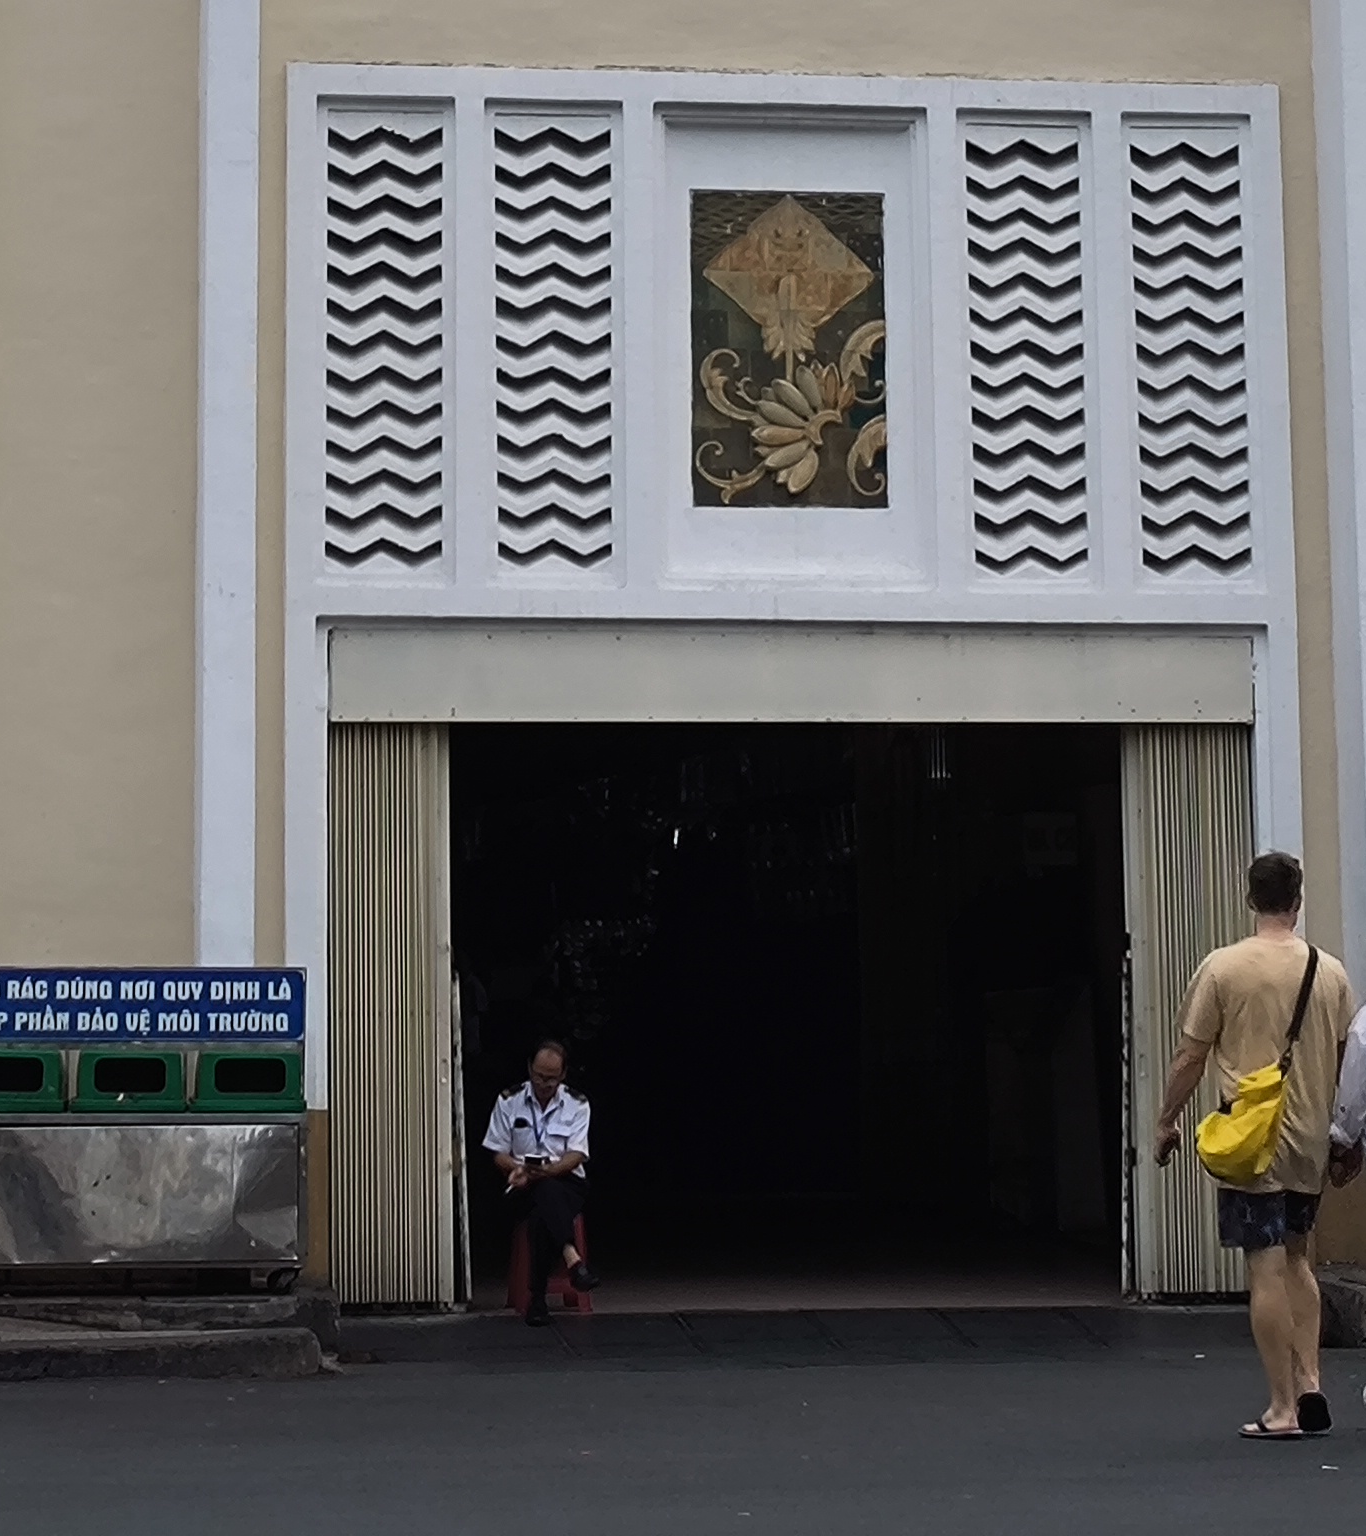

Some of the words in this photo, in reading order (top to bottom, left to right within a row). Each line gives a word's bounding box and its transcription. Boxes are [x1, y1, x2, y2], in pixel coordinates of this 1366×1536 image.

[7, 975, 48, 1000] RÁC
[55, 976, 113, 1000] ĐÚNG
[119, 979, 156, 1001] NƠI
[162, 980, 204, 1002] QUY
[209, 980, 261, 1005] ĐỊNH
[267, 977, 292, 1001] LÀ
[14, 1004, 70, 1031] PHẦN
[77, 1006, 119, 1031] BẢO
[125, 1008, 151, 1035] VỆ
[157, 1008, 201, 1032] MÔI
[206, 1009, 289, 1032] TRƯỜNG
